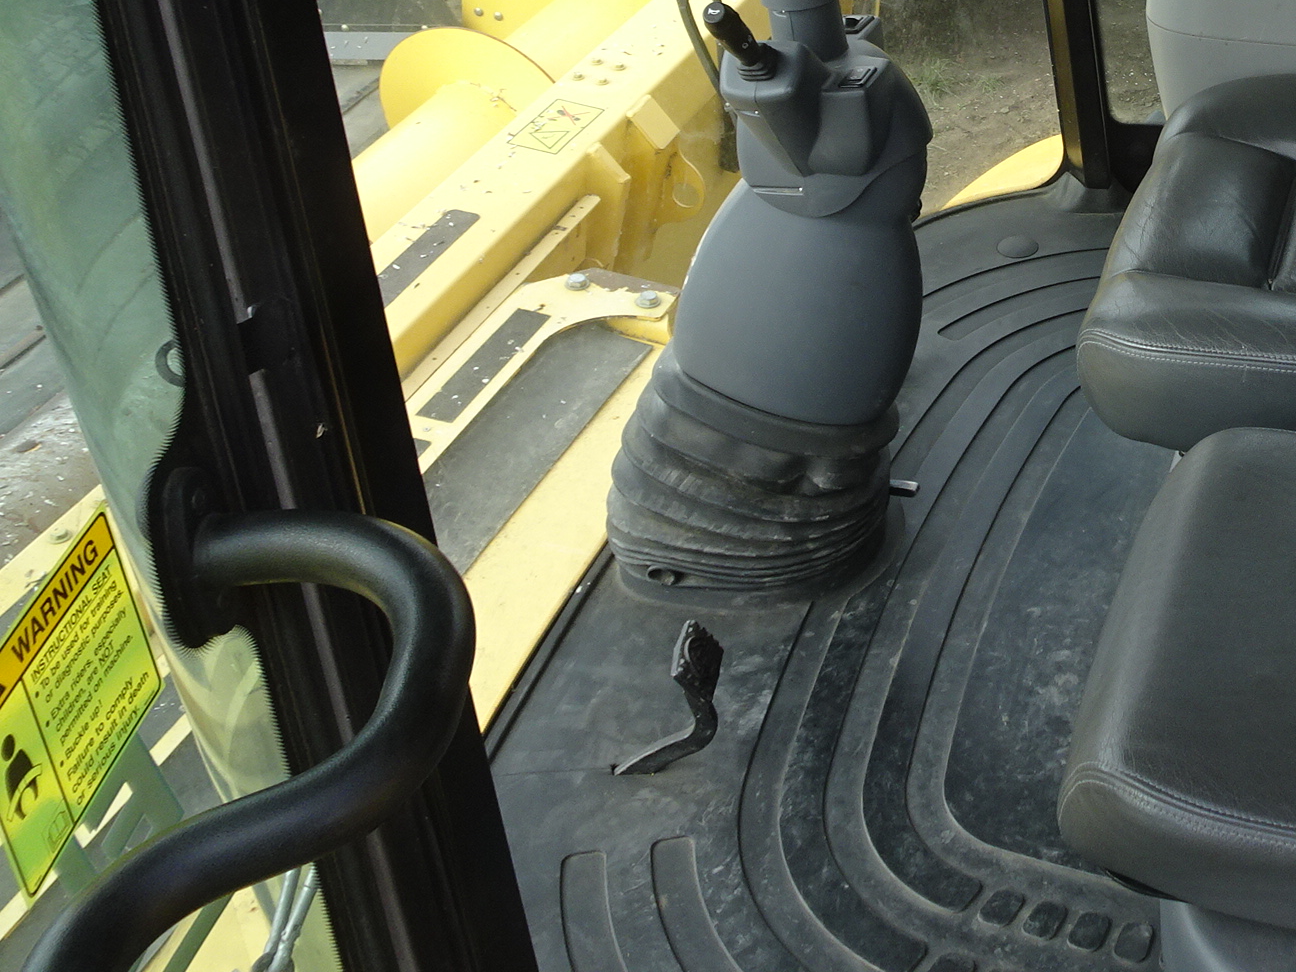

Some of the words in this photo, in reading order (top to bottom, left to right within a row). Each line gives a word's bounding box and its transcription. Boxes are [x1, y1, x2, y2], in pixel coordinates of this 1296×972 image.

[11, 539, 99, 663] WARNING
[30, 595, 92, 683] INSTRUCTIONAL
[92, 564, 112, 595] SEAT
[40, 676, 50, 690] To
[50, 661, 60, 676] be
[62, 632, 80, 660] used
[80, 617, 90, 634] for
[90, 580, 118, 618] training
[45, 688, 53, 703] or
[55, 635, 90, 689] diagnostic
[50, 691, 70, 720] Extra
[94, 607, 126, 656] especially
[60, 691, 93, 747] permitted
[94, 678, 104, 692] on
[86, 666, 98, 686] are
[98, 639, 114, 668] NOT
[64, 722, 90, 760] Buckle
[66, 737, 94, 782] Failure
[95, 722, 104, 736] to
[106, 676, 133, 720] comply
[72, 754, 94, 794] could
[95, 718, 118, 756] result
[118, 706, 127, 719] in
[128, 672, 150, 704] death
[76, 789, 85, 806] or
[87, 742, 116, 789] serious
